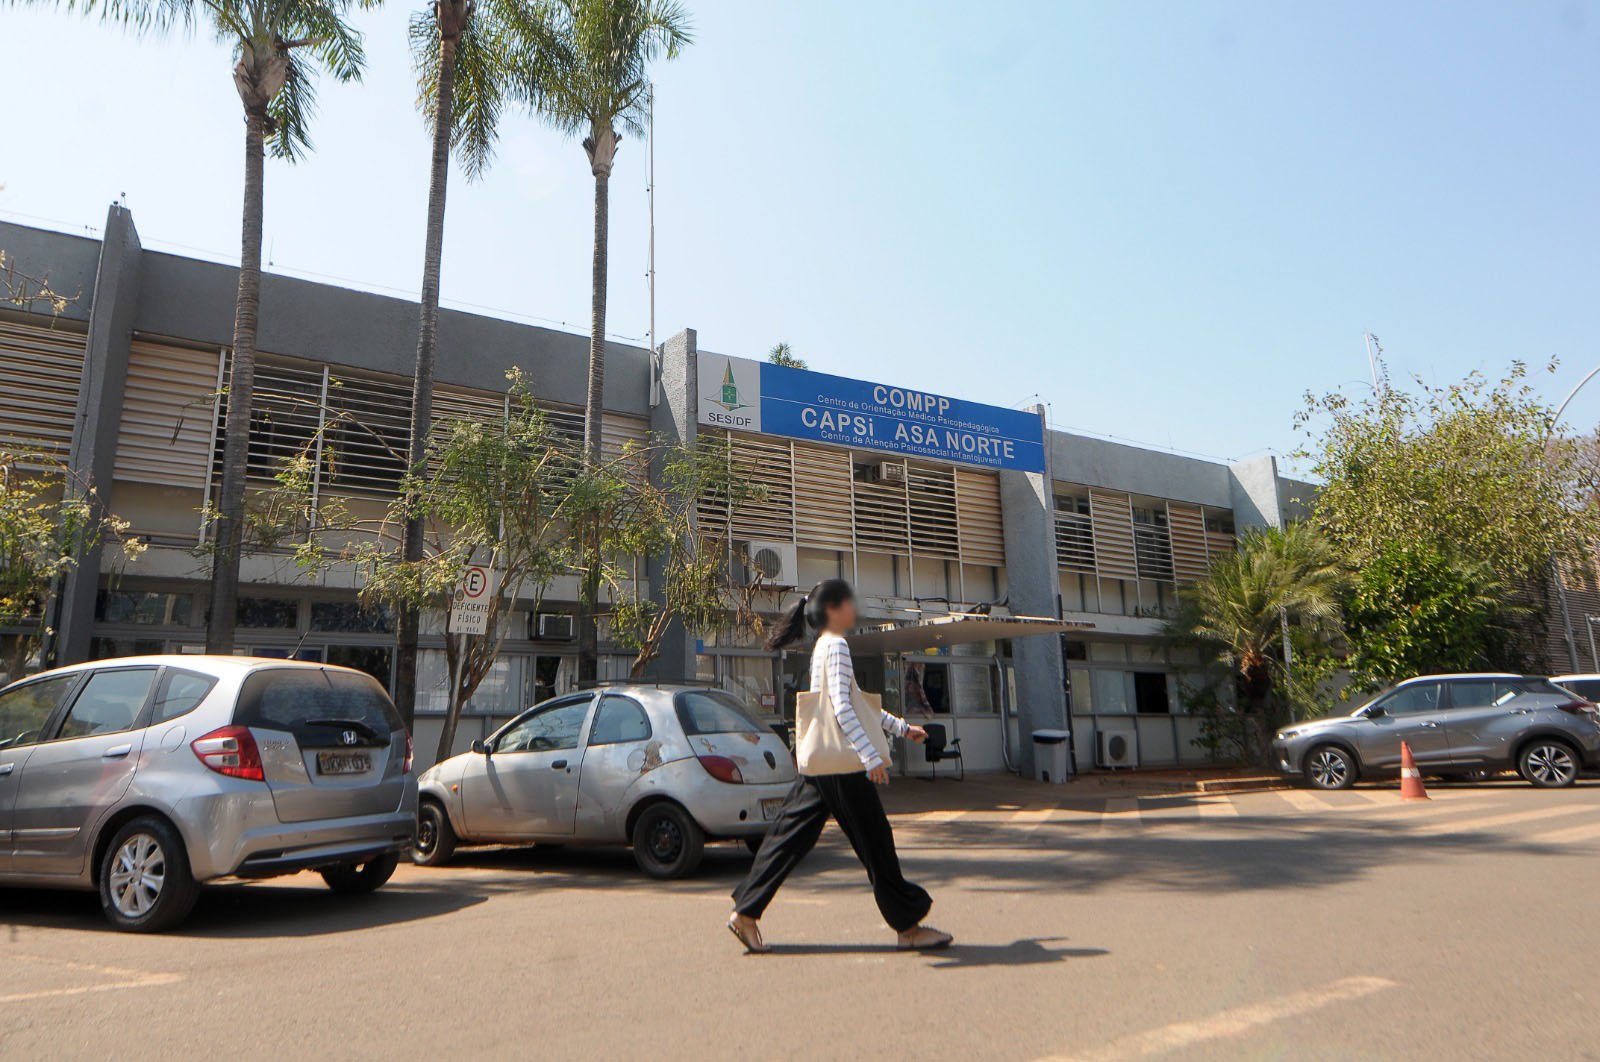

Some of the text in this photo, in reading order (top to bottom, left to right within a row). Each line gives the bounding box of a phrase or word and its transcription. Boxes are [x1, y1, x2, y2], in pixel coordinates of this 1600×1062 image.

[817, 394, 847, 407] Centro
[848, 400, 859, 409] de
[861, 402, 906, 417] Orientação
[908, 410, 936, 422] Médico
[873, 385, 950, 415] COMPP
[708, 412, 752, 427] SES/DF
[801, 407, 1015, 459] CAPSi ASA NORTE
[821, 430, 850, 442] Centro
[852, 436, 863, 444] de
[864, 436, 899, 449] Atenção
[901, 442, 950, 457] Psicossocial
[469, 573, 480, 591] E
[452, 601, 489, 612] DEFICIENTE
[457, 612, 481, 624] FÍSICO
